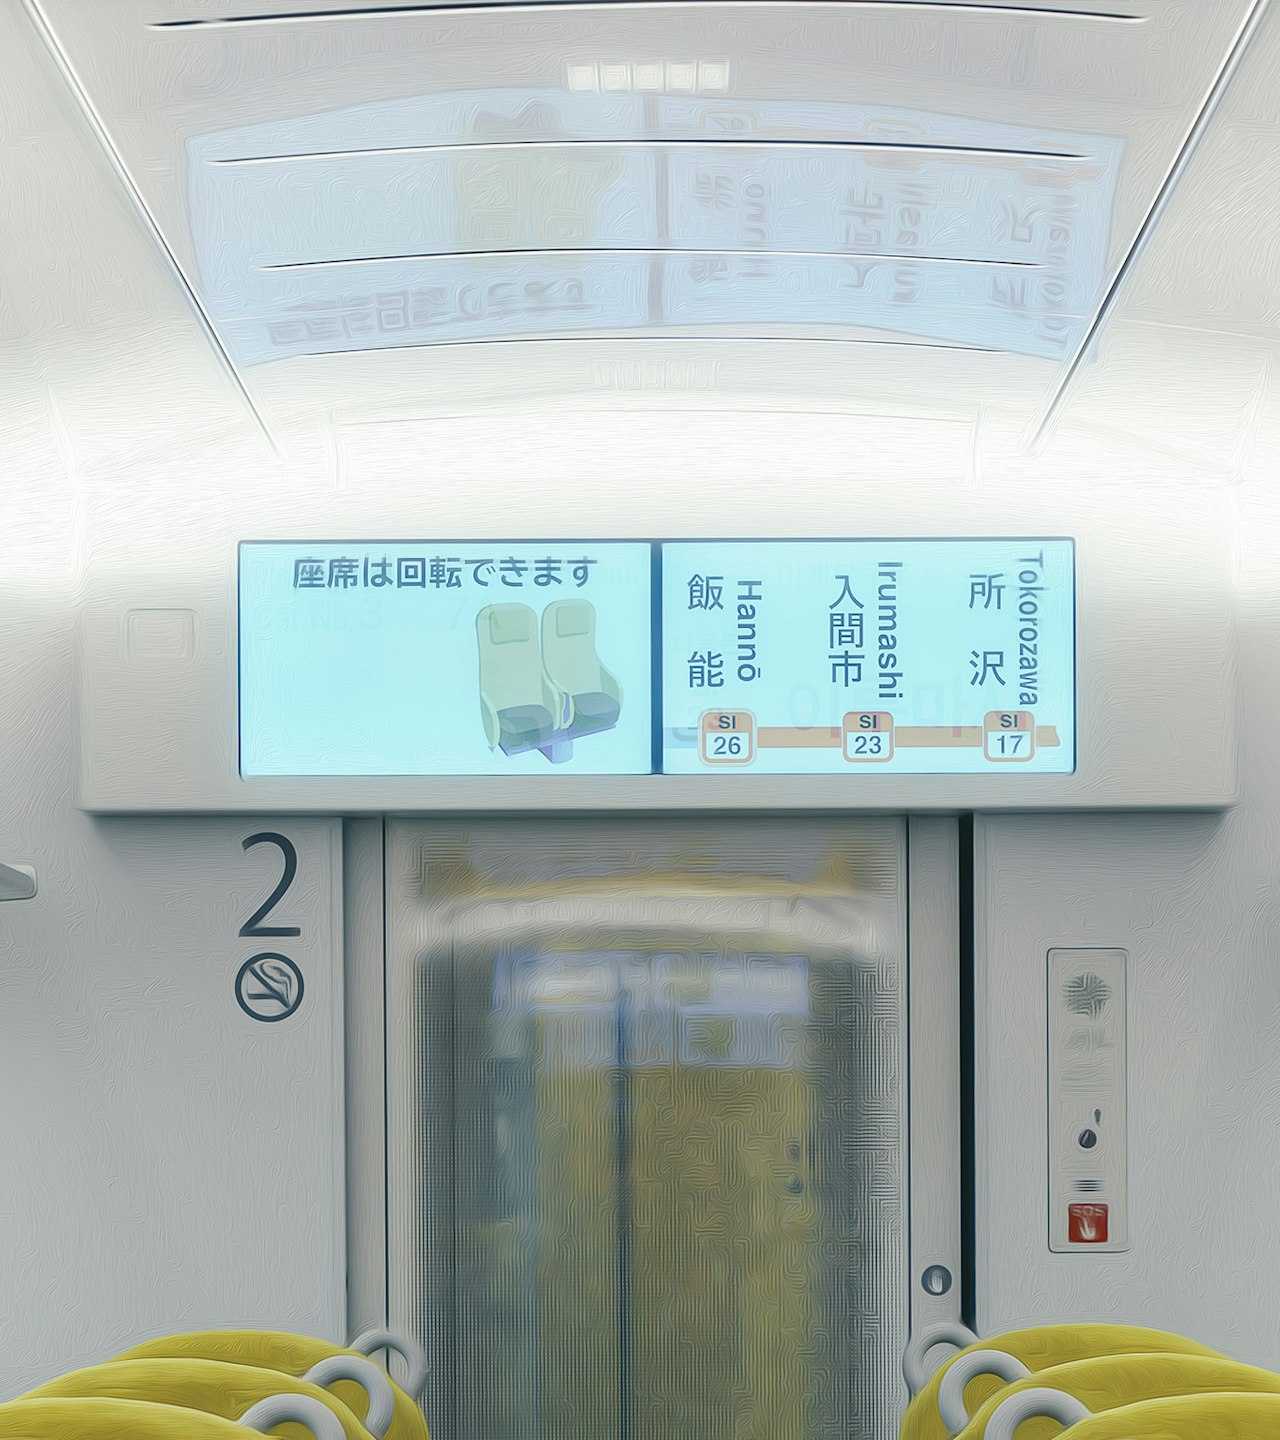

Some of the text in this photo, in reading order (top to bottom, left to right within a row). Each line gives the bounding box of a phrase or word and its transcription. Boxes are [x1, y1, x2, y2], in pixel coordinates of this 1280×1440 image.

[293, 556, 598, 589] 座席は回転できます
[687, 574, 725, 688] 飯能
[737, 580, 762, 682] Hannō
[828, 575, 865, 688] 入間市
[878, 562, 903, 698] Irumashi
[969, 573, 1006, 687] 所沢
[1018, 549, 1044, 706] Tokorozawa
[713, 735, 742, 755] 26
[719, 714, 737, 730] SI
[854, 735, 882, 755] 23
[859, 714, 878, 729] SI
[996, 735, 1023, 754] 17
[1000, 713, 1018, 728] SI
[238, 831, 302, 938] 2
